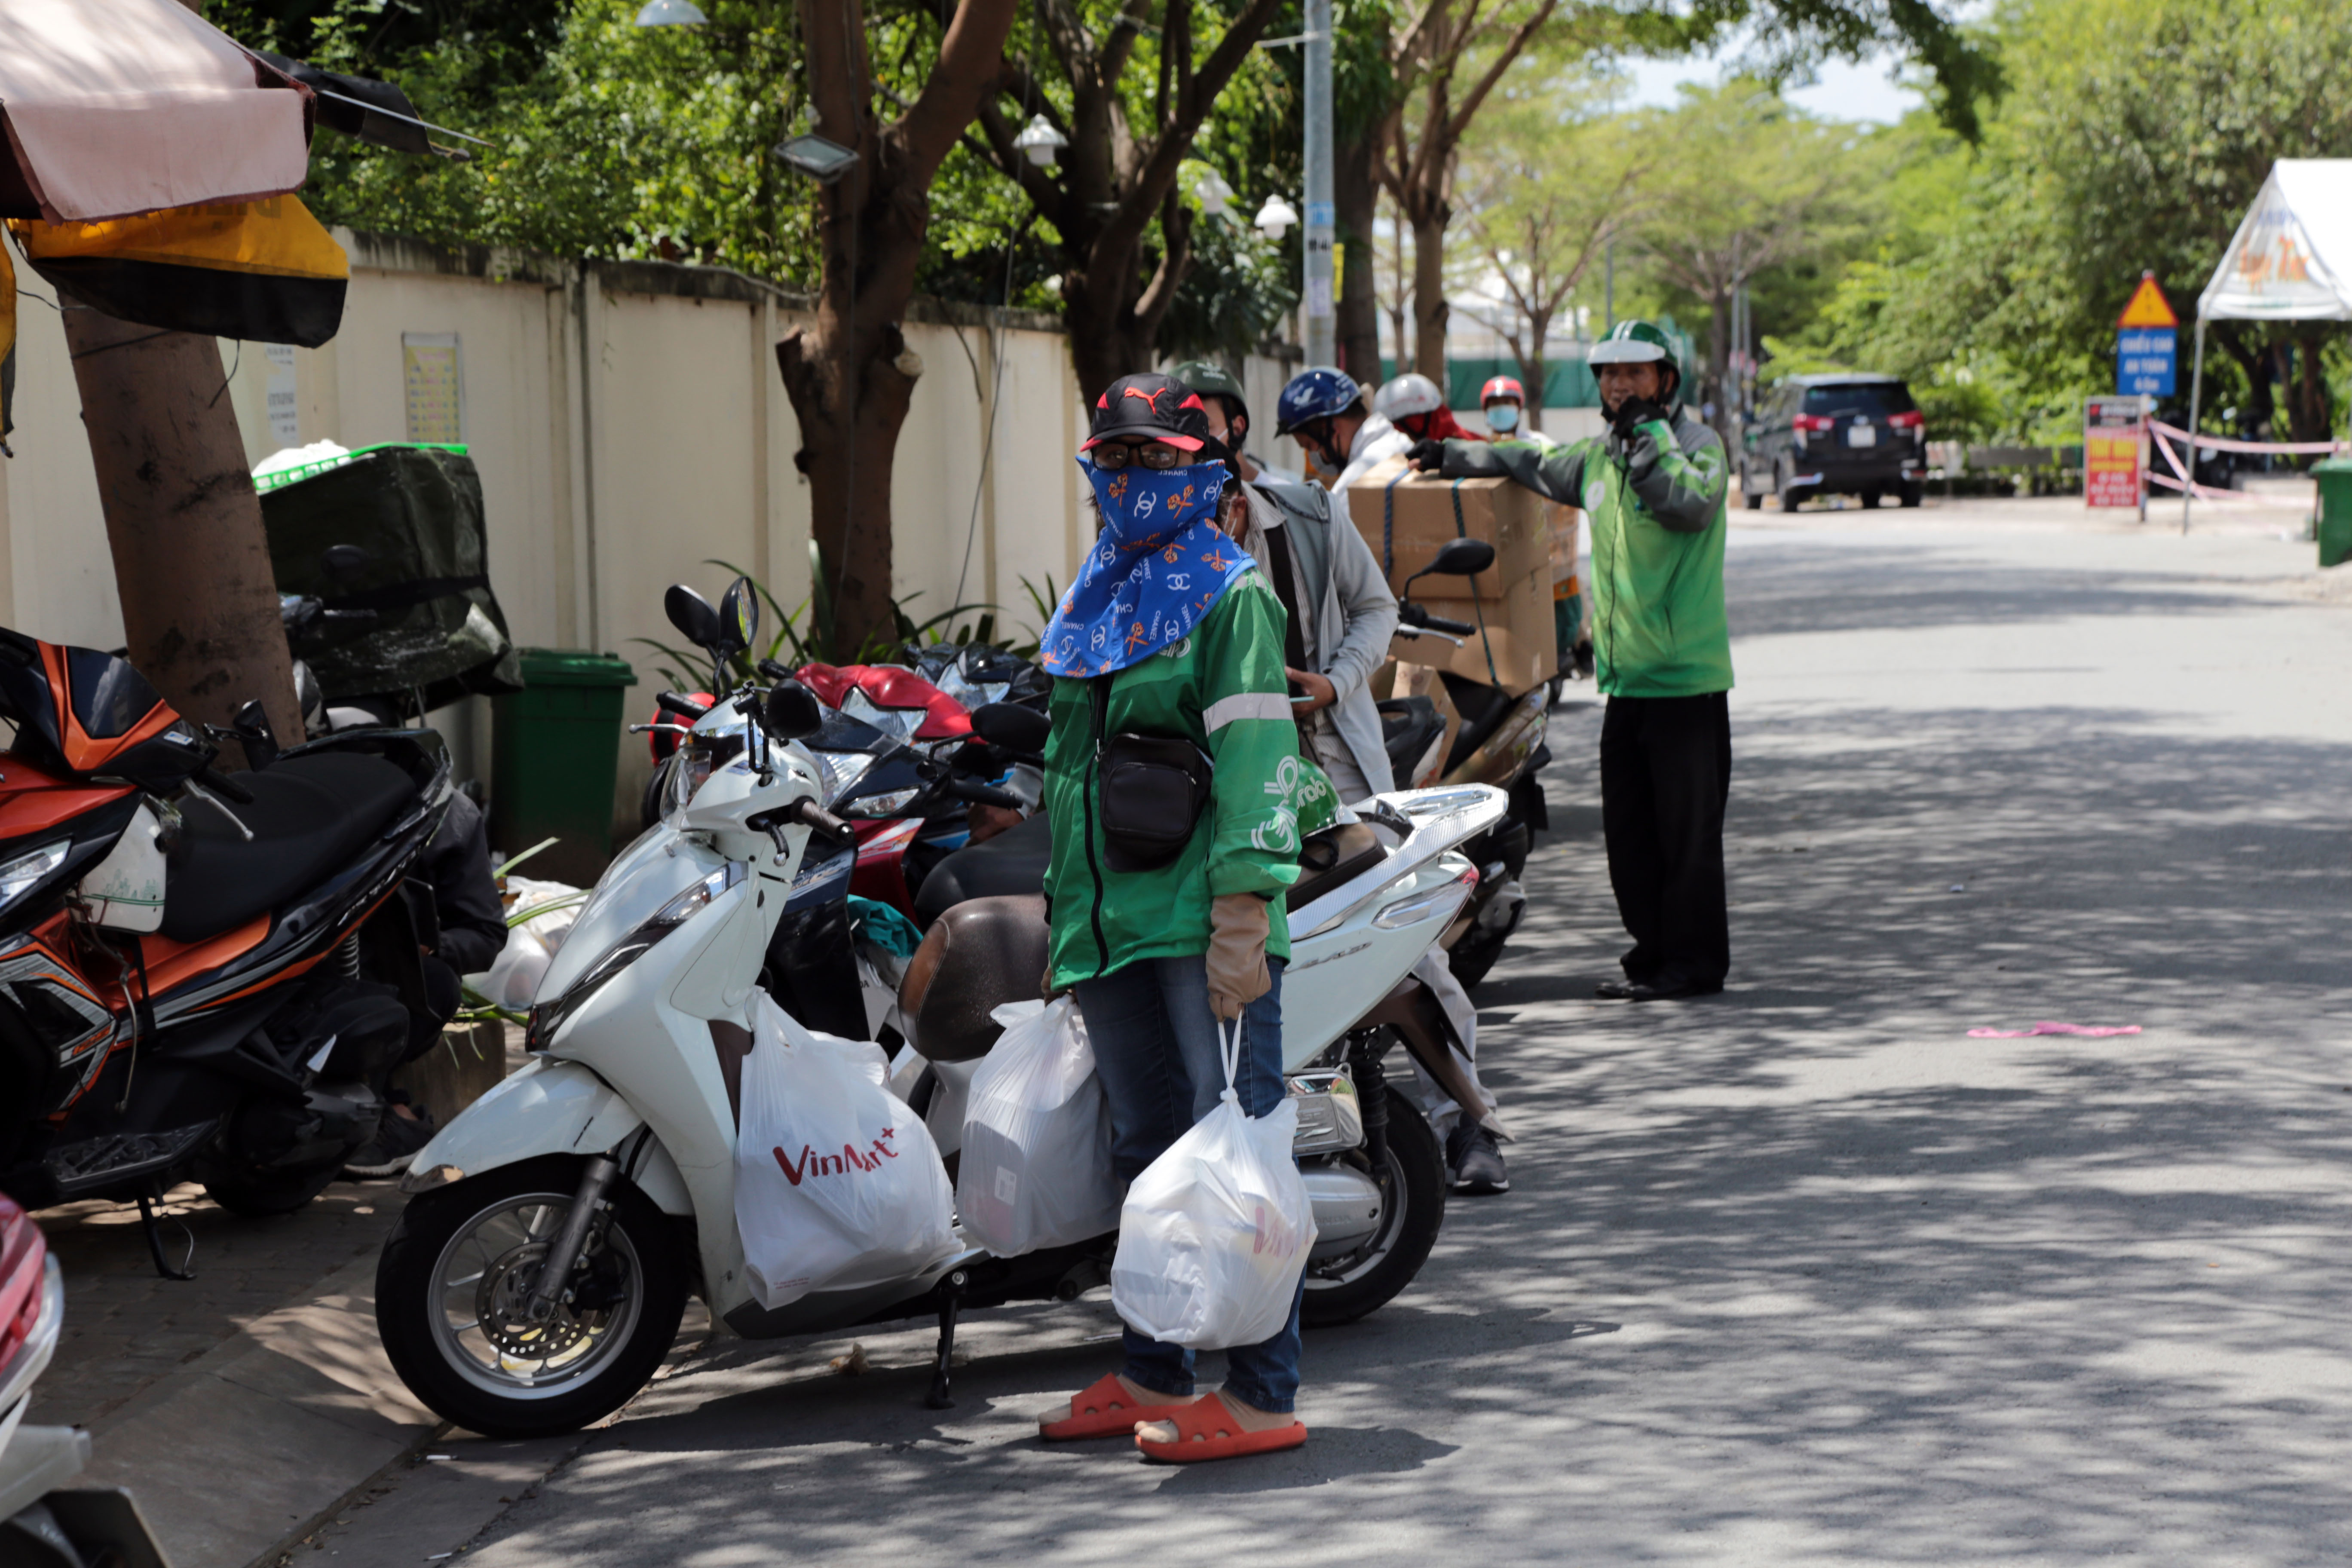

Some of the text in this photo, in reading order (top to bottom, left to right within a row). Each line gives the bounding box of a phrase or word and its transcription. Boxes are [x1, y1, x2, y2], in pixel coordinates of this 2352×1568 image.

[1106, 511, 1123, 538] CHANEL
[1061, 622, 1084, 630] CHANEL
[1149, 610, 1161, 641] CHANEL
[1181, 603, 1192, 630] HANEL
[1063, 646, 1081, 667] CHANEL
[1296, 775, 1326, 810] rab
